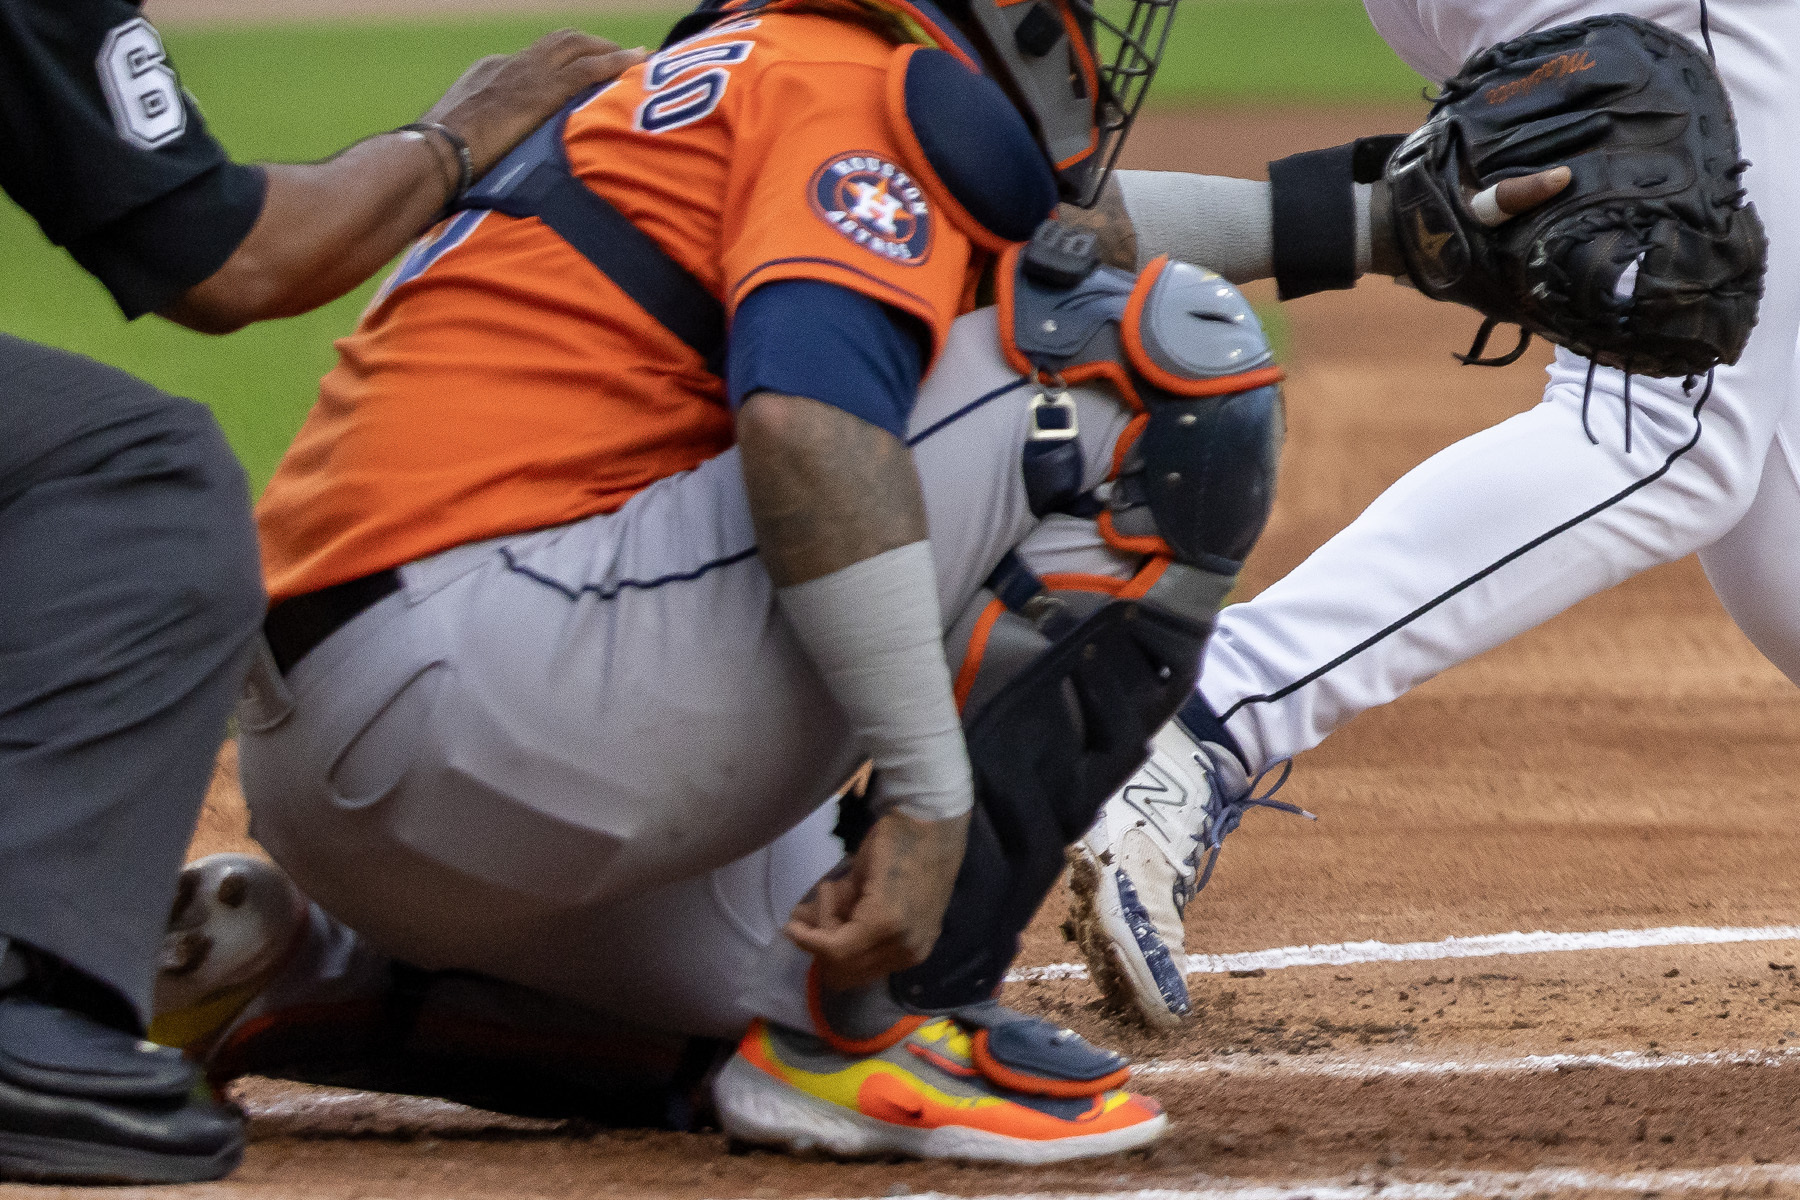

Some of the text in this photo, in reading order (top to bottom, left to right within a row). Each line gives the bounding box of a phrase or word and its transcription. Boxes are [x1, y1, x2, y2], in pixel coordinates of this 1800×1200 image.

[96, 17, 187, 150] 6
[831, 157, 929, 215] HOUSTON
[824, 210, 913, 260] ASTROS
